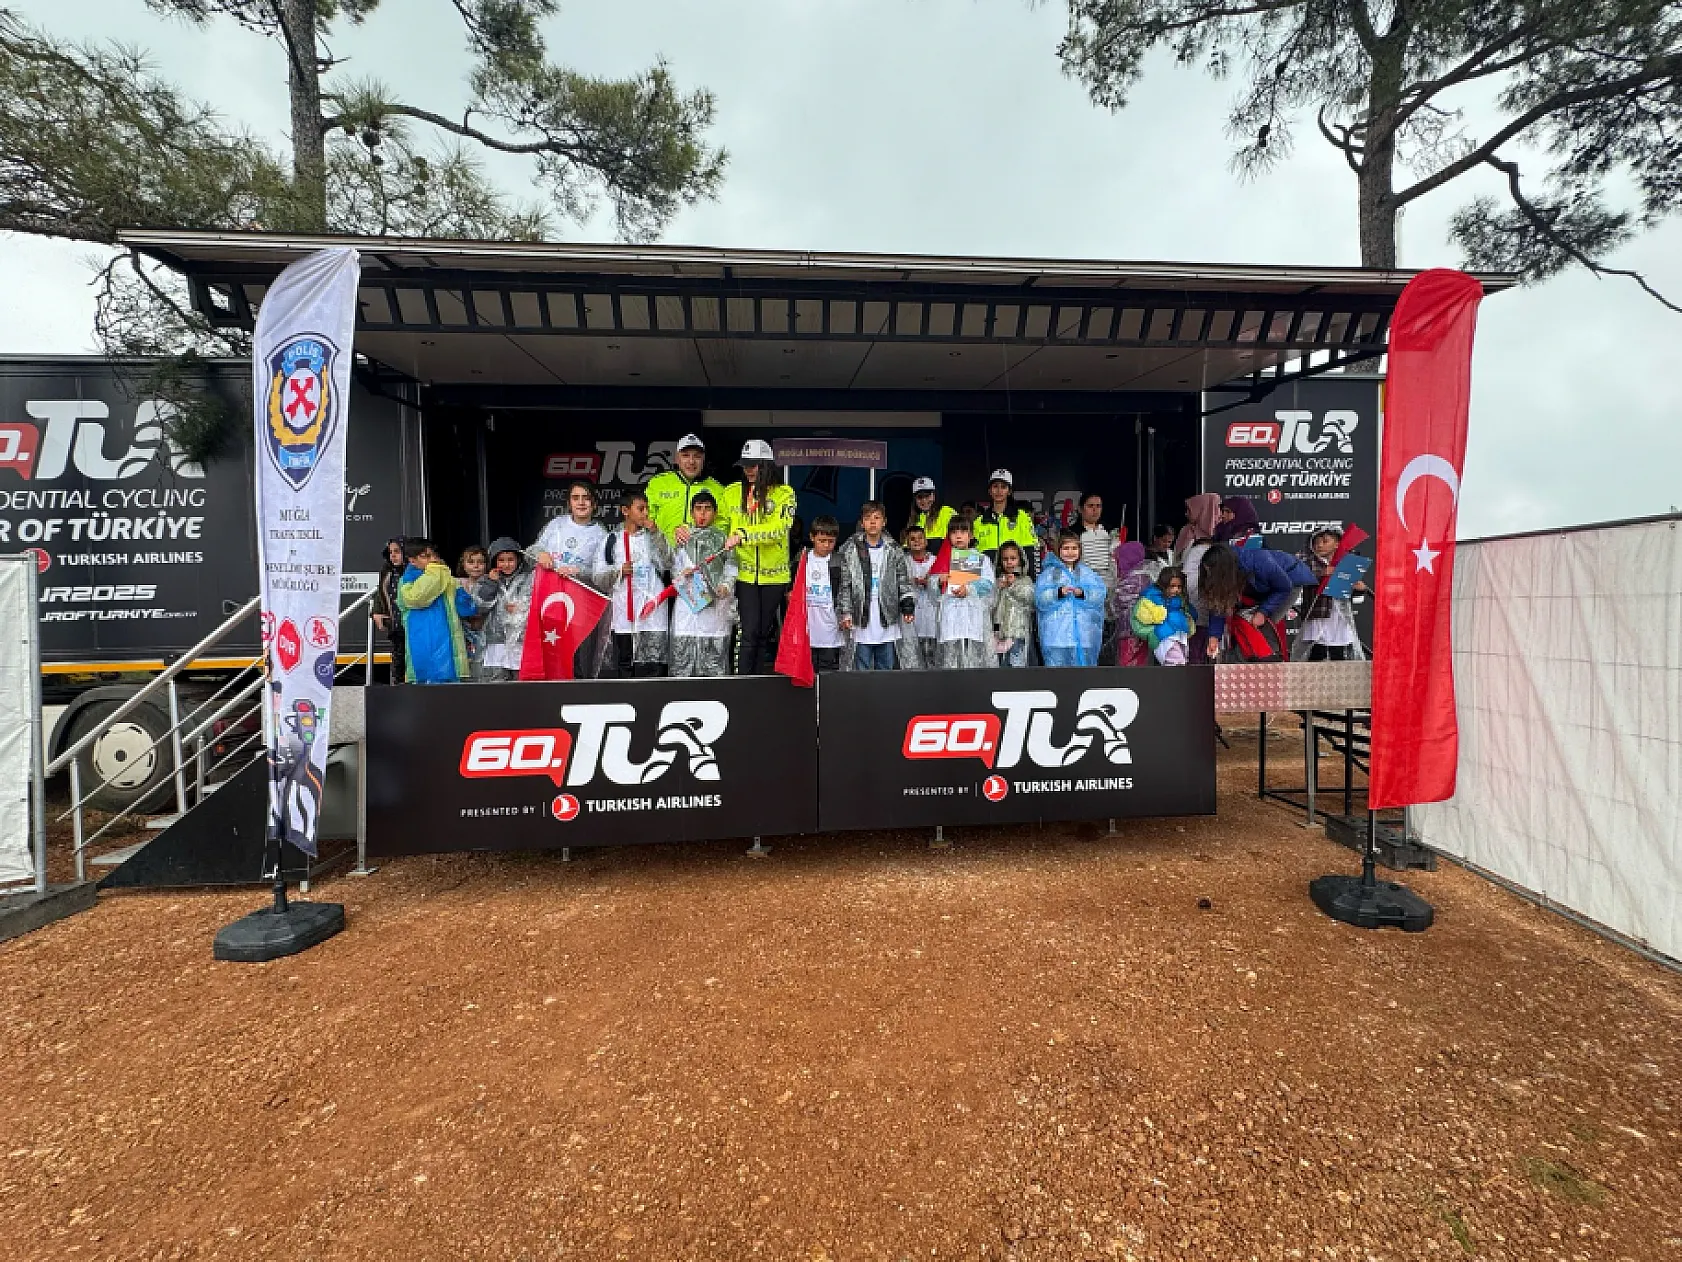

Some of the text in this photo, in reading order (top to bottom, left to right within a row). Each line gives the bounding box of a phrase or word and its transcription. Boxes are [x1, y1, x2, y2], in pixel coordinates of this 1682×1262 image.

[1275, 410, 1359, 453] TUR
[1225, 457, 1353, 469] PRESIDENTIAL CYCLING
[1225, 471, 1351, 487] TOUR OF TÜRKİYE
[102, 488, 206, 509] CYCLING
[18, 518, 63, 542] OF
[68, 510, 204, 541] TÜRKİYE
[57, 551, 204, 566] TURKISH AIRLINES
[909, 688, 1139, 767] 60. TUR
[467, 701, 729, 786] 60. TUR
[1013, 778, 1133, 794] TURKISH AIRLINES
[460, 805, 536, 817] PRESENTED BY
[585, 795, 722, 813] TURKISH AIRLINES
